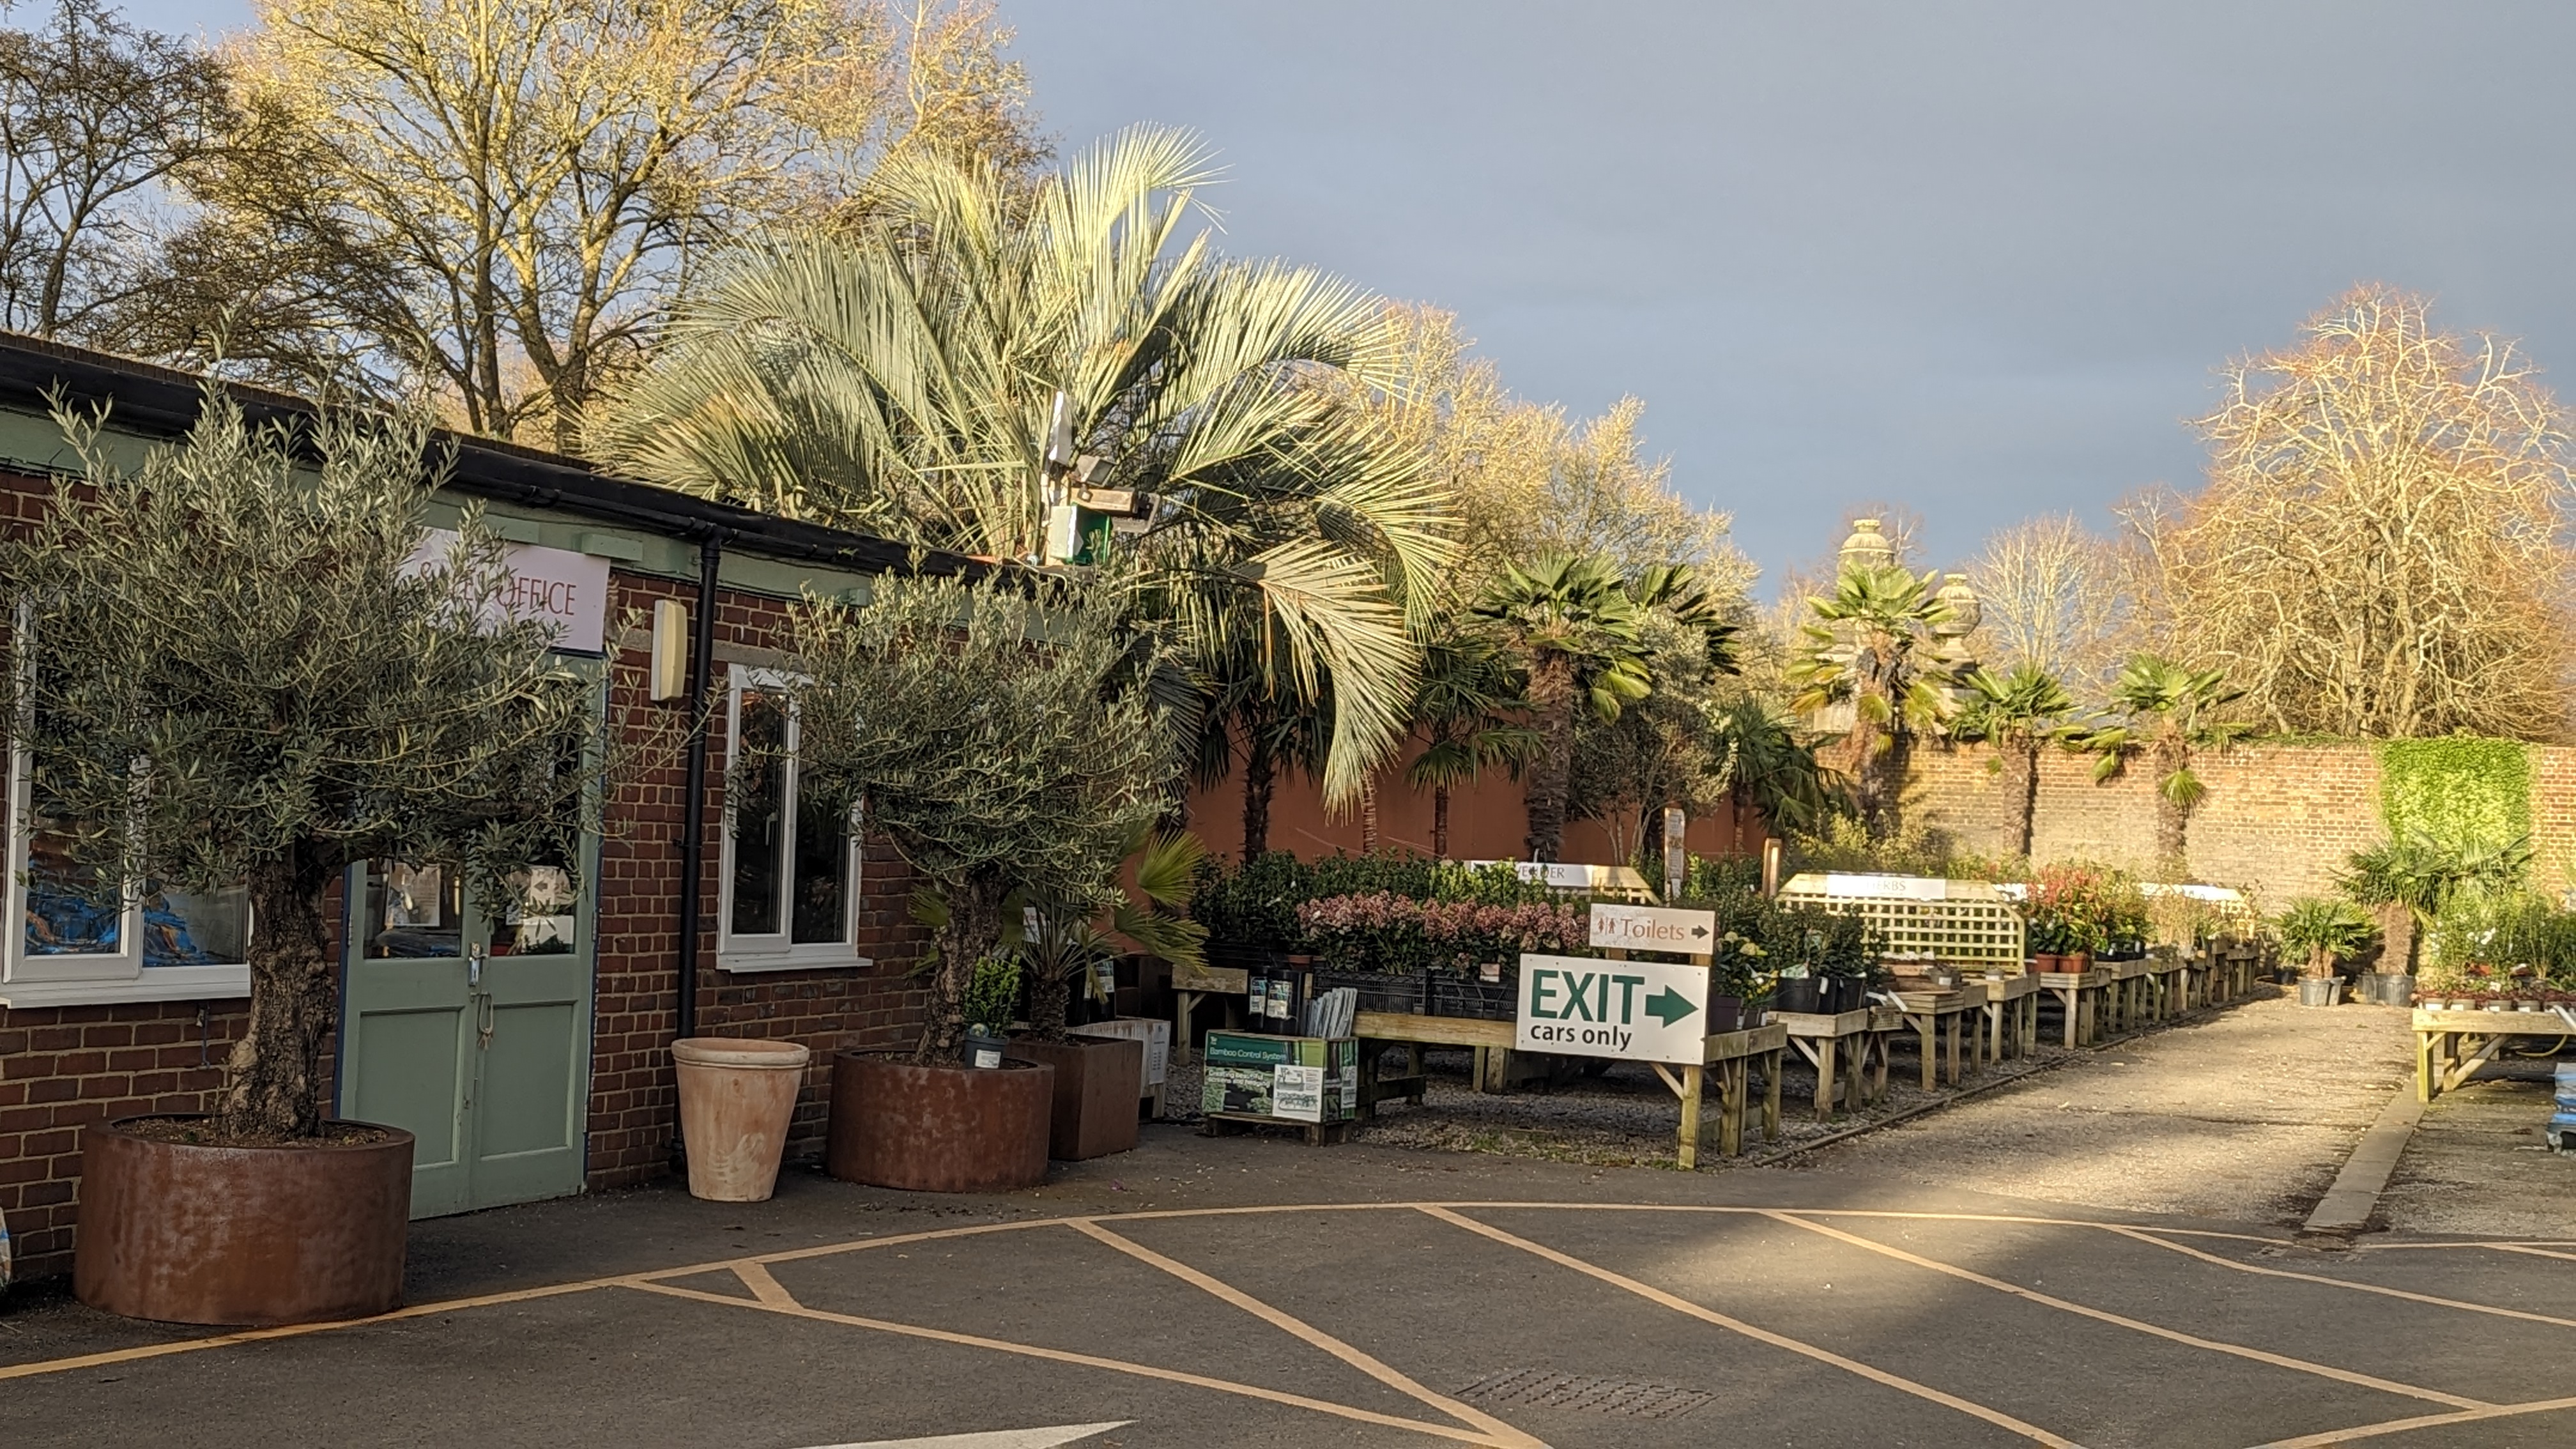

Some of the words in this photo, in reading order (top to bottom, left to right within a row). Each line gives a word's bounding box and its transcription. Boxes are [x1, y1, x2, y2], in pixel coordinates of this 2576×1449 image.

[496, 575, 576, 615] OFFICE
[1866, 880, 1906, 891] HERBS
[1620, 918, 1685, 940] Toilets
[1531, 969, 1645, 1025] EXIT
[1531, 1025, 1575, 1043] cars
[1582, 1025, 1632, 1052] only
[1209, 1046, 1238, 1057] Bamboo
[1238, 1049, 1261, 1059] Control
[1262, 1052, 1287, 1061] System
